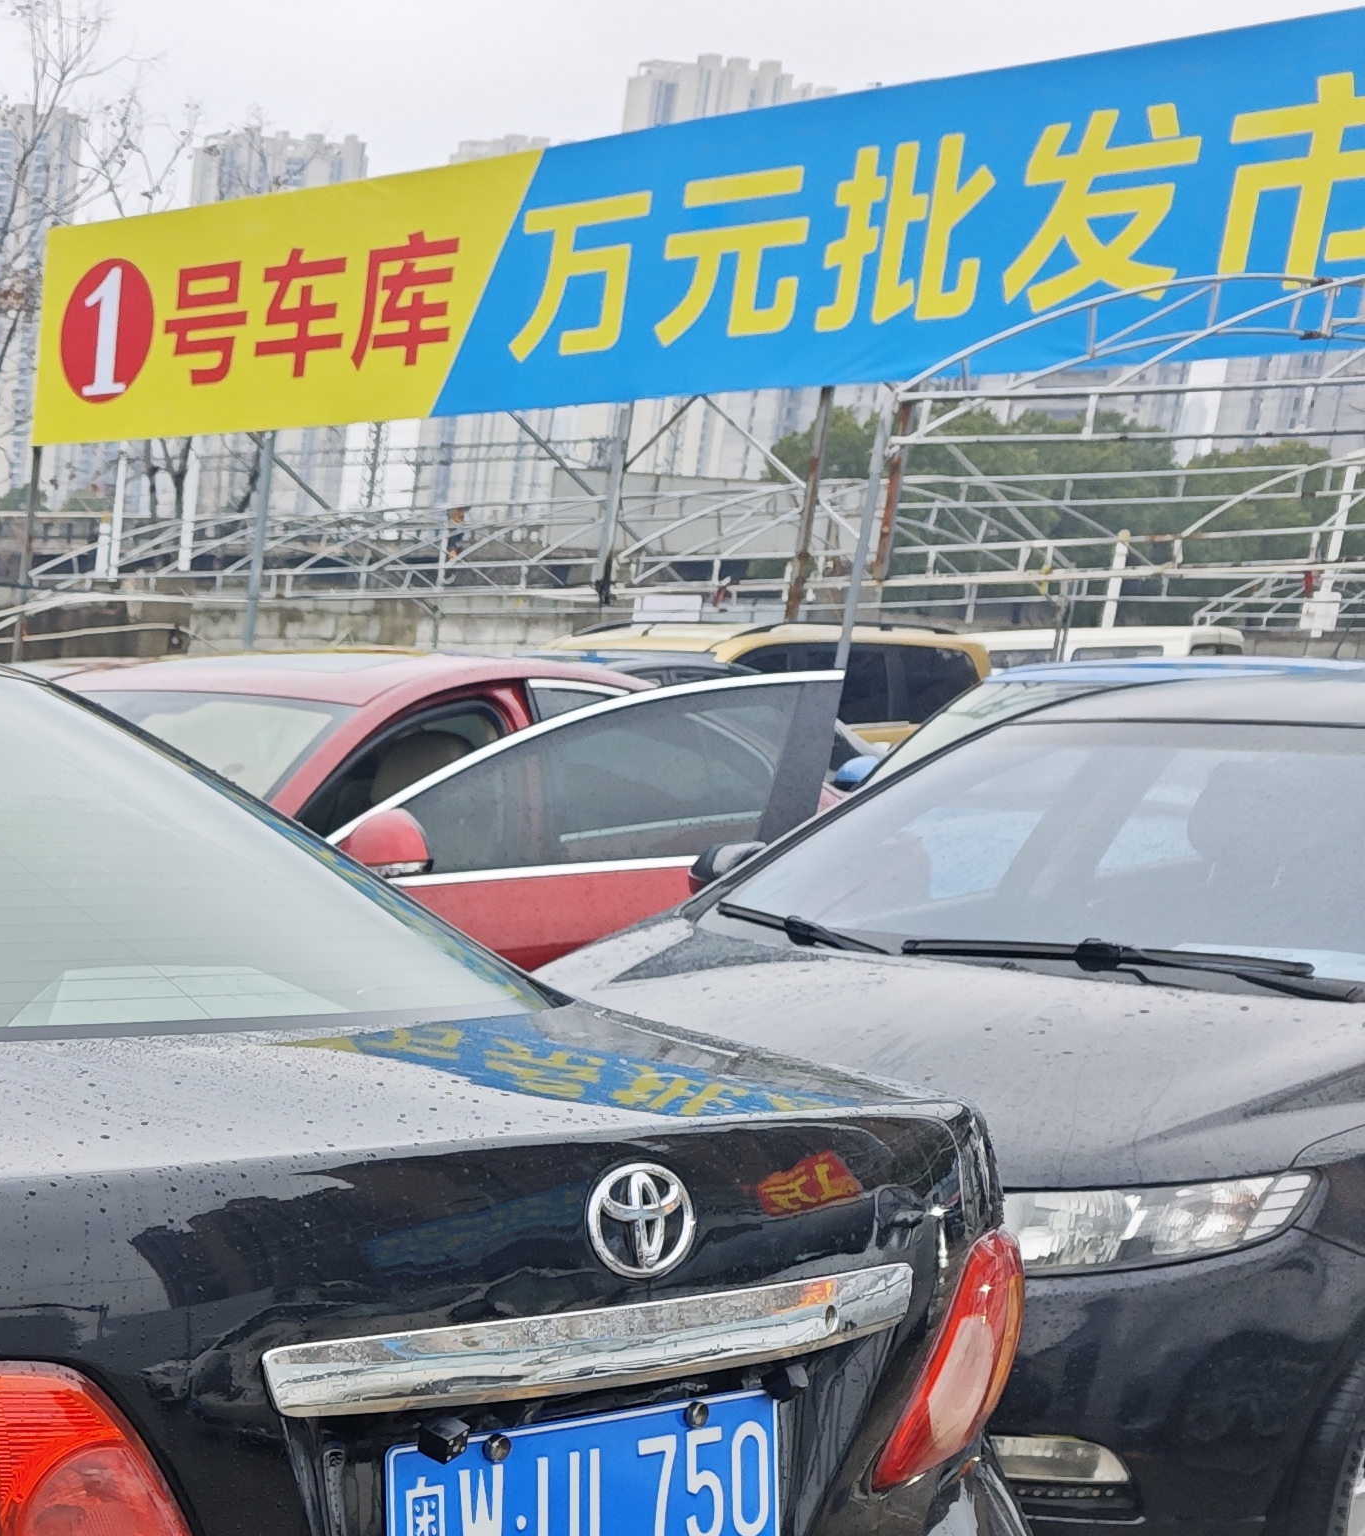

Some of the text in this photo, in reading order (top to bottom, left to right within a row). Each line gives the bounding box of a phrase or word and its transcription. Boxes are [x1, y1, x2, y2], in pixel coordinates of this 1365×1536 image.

[509, 71, 1365, 361] 万元批发市
